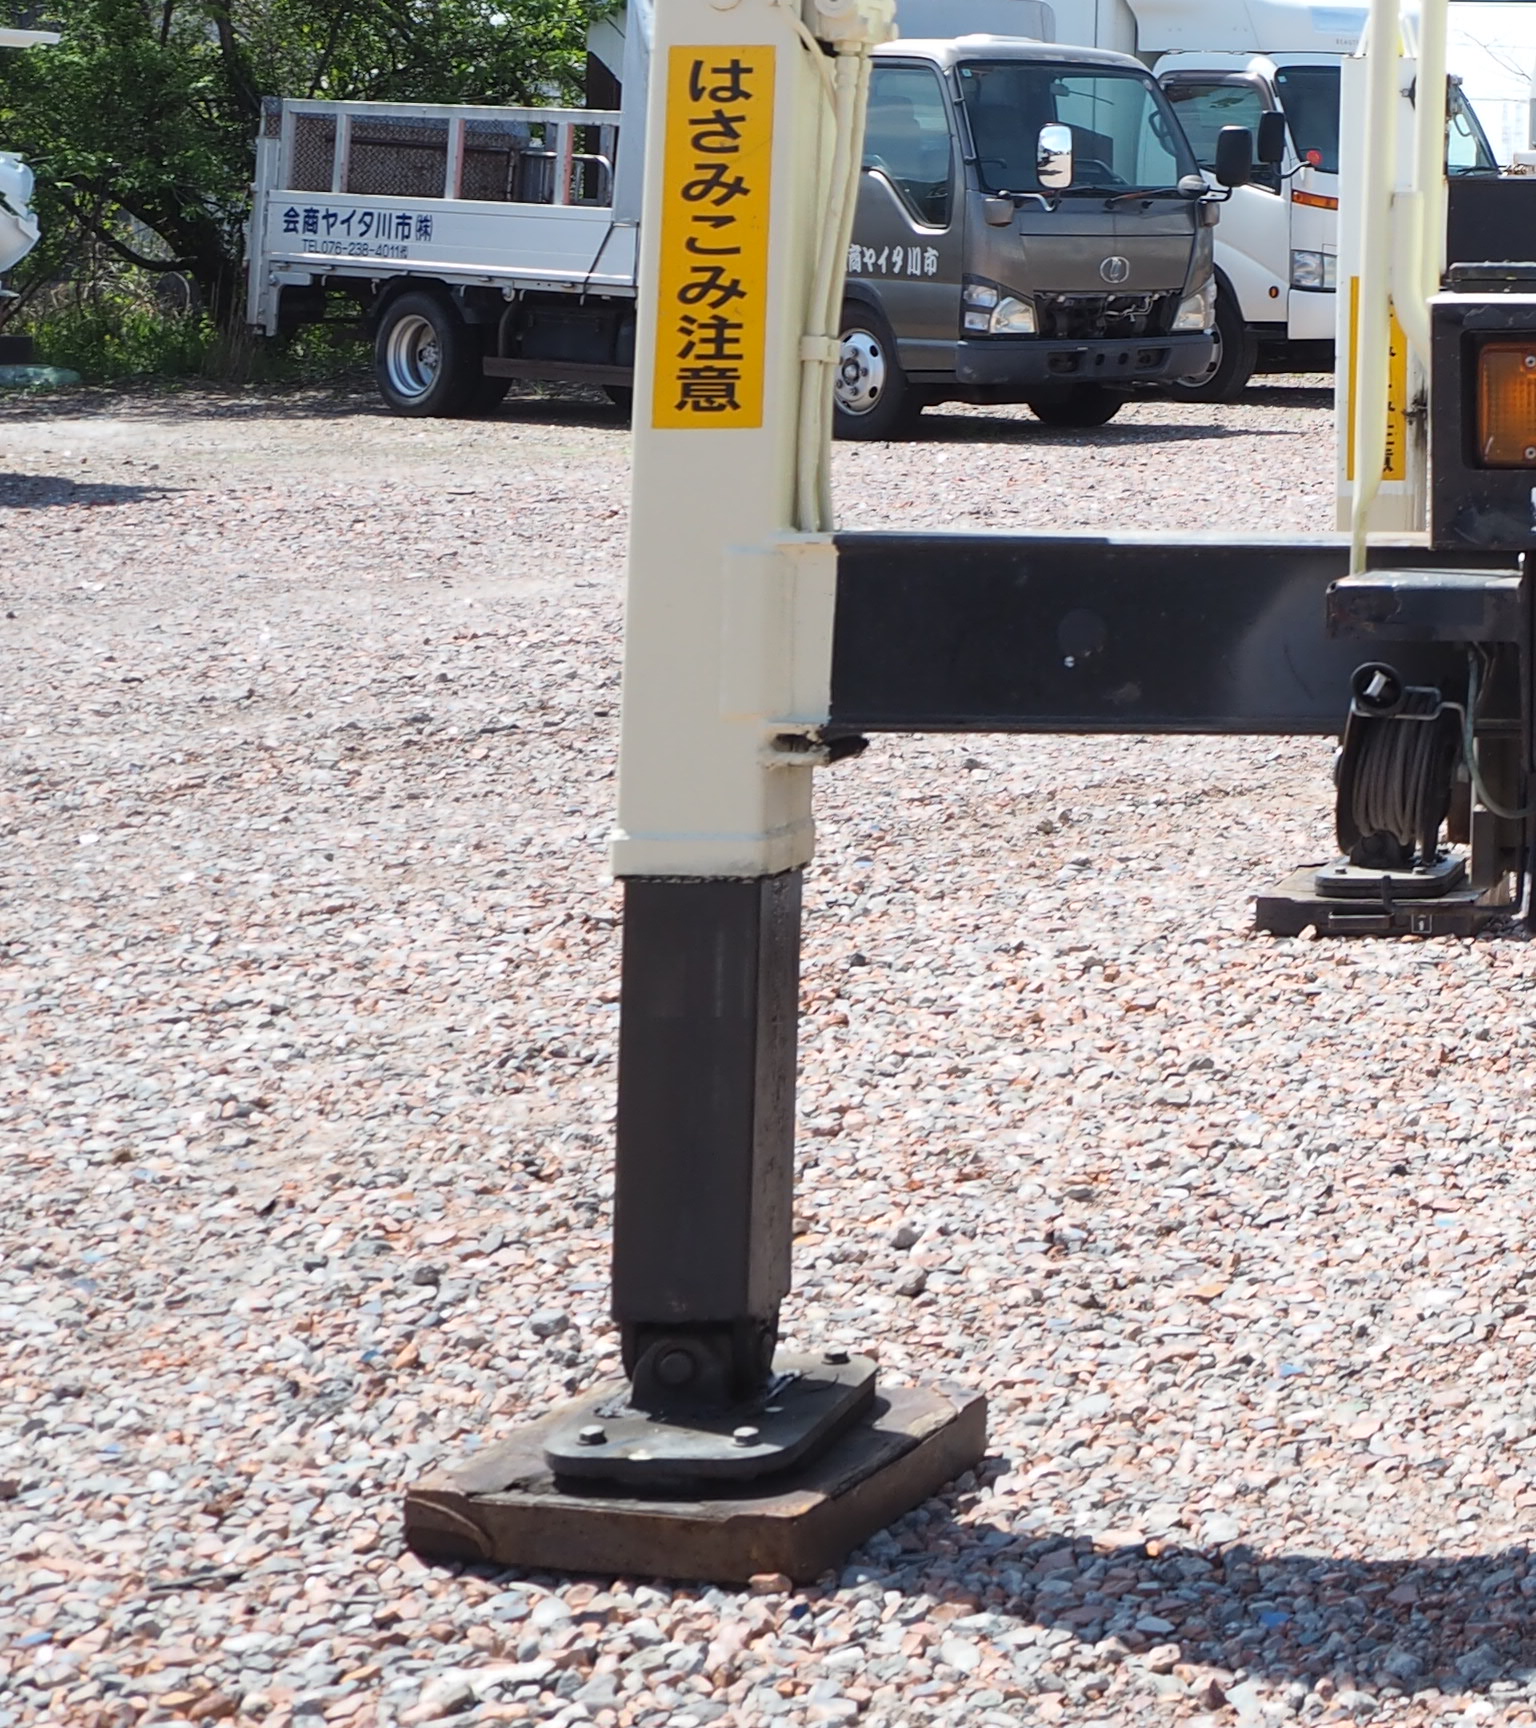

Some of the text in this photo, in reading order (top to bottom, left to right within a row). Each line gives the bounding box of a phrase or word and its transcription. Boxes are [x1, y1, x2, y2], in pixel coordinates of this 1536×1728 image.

[674, 59, 754, 414] はさみこみ注意
